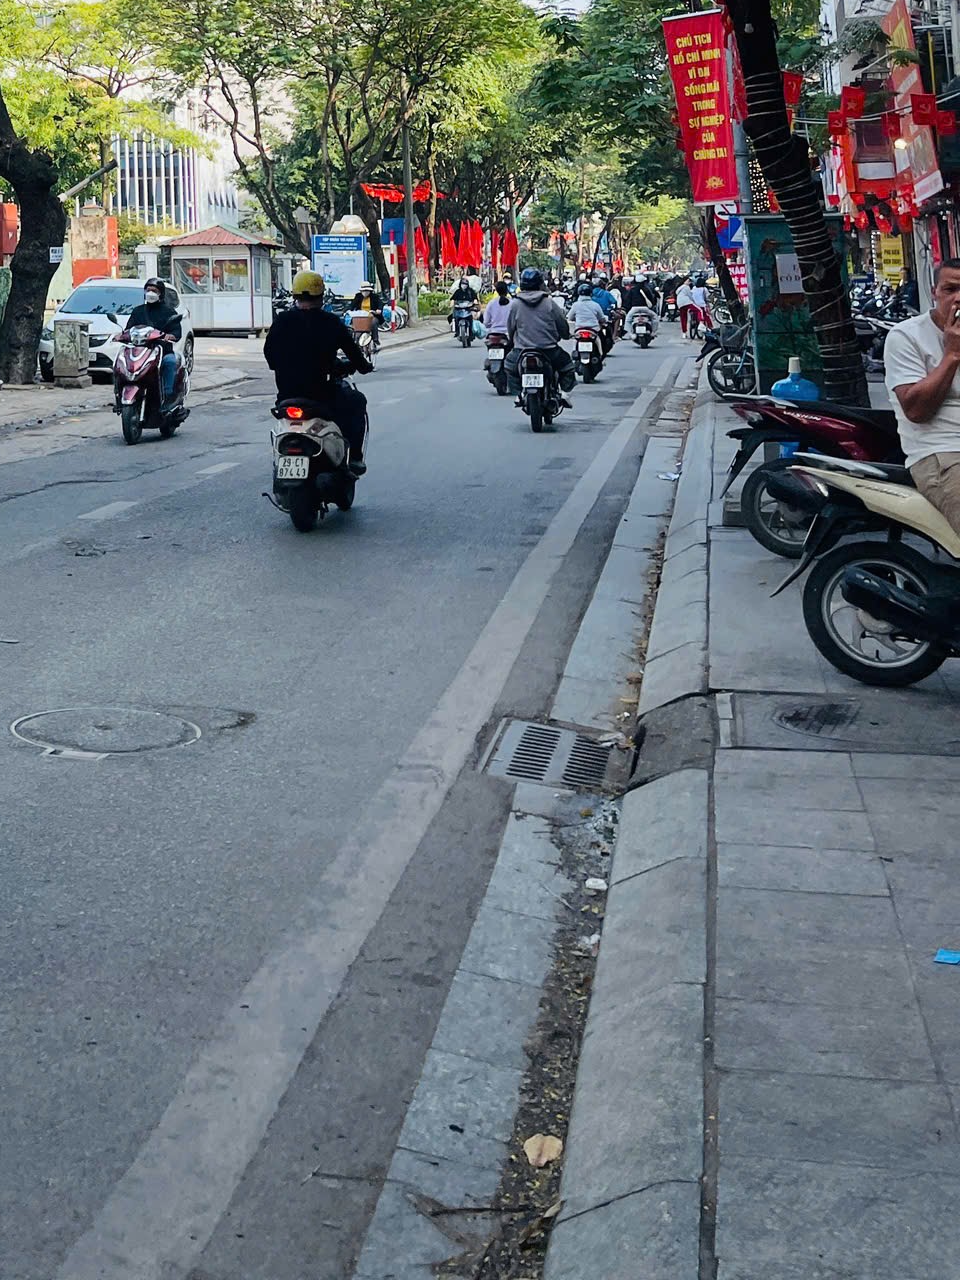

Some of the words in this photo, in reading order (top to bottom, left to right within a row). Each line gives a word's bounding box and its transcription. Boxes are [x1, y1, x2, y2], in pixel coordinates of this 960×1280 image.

[676, 33, 693, 48] CHỦ
[693, 32, 712, 47] TỊCH
[673, 51, 685, 65] HỒ
[686, 49, 700, 63] CHÍ
[701, 48, 721, 61] MINH
[684, 82, 706, 97] SỐNG
[706, 79, 720, 93] MÃI
[692, 99, 716, 112] TRONG
[688, 117, 700, 130] SỰ
[701, 113, 725, 128] NGHIỆP
[702, 130, 716, 143] CỦA
[693, 146, 716, 160] CHÚNG
